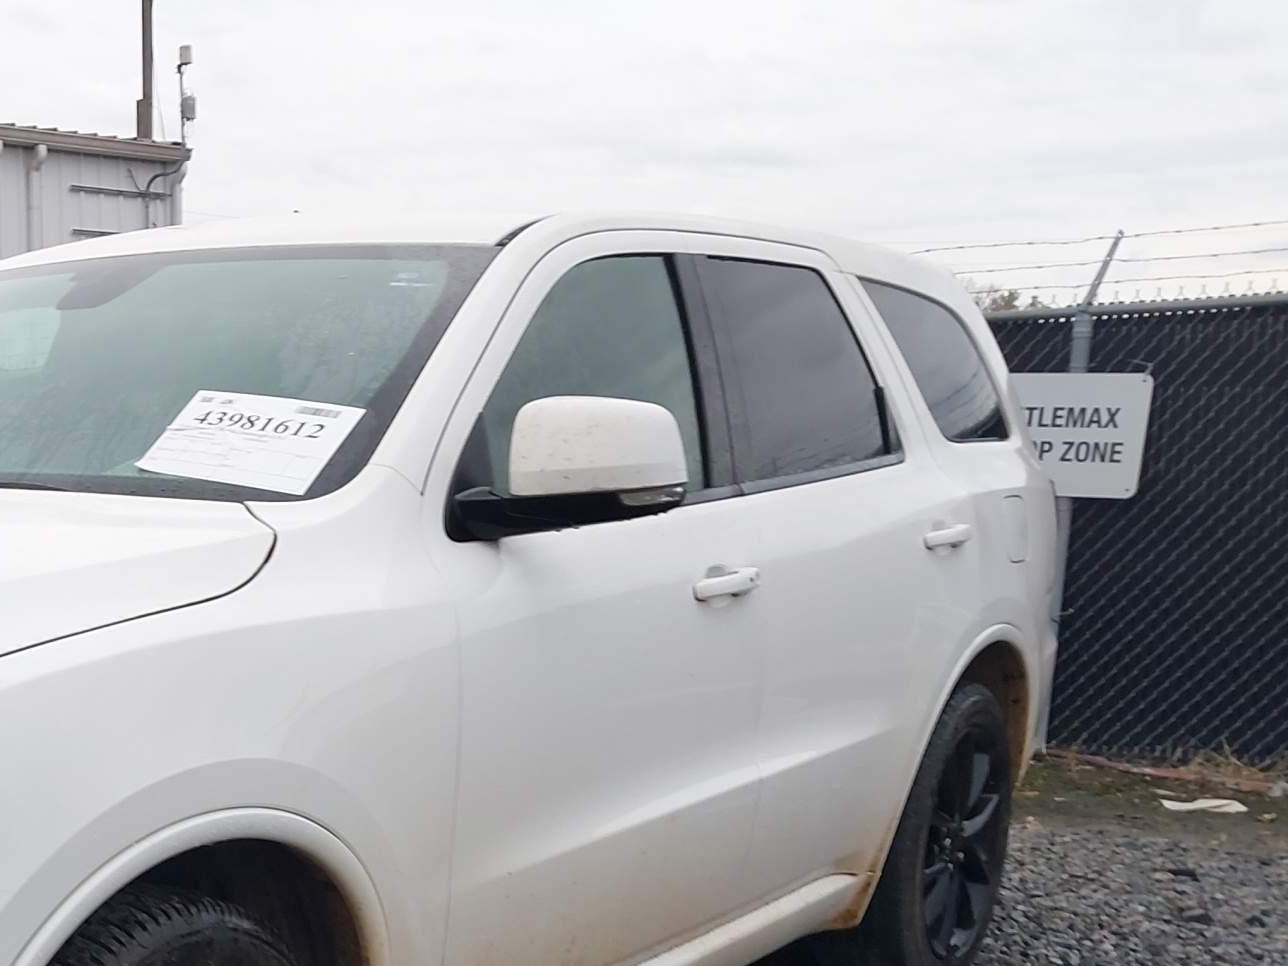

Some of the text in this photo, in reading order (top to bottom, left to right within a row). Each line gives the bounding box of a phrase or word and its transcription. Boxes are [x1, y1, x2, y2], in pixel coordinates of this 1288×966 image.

[193, 410, 325, 439] 43981612
[1021, 406, 1121, 428] TLEMAX
[1032, 440, 1124, 463] P ZONE
